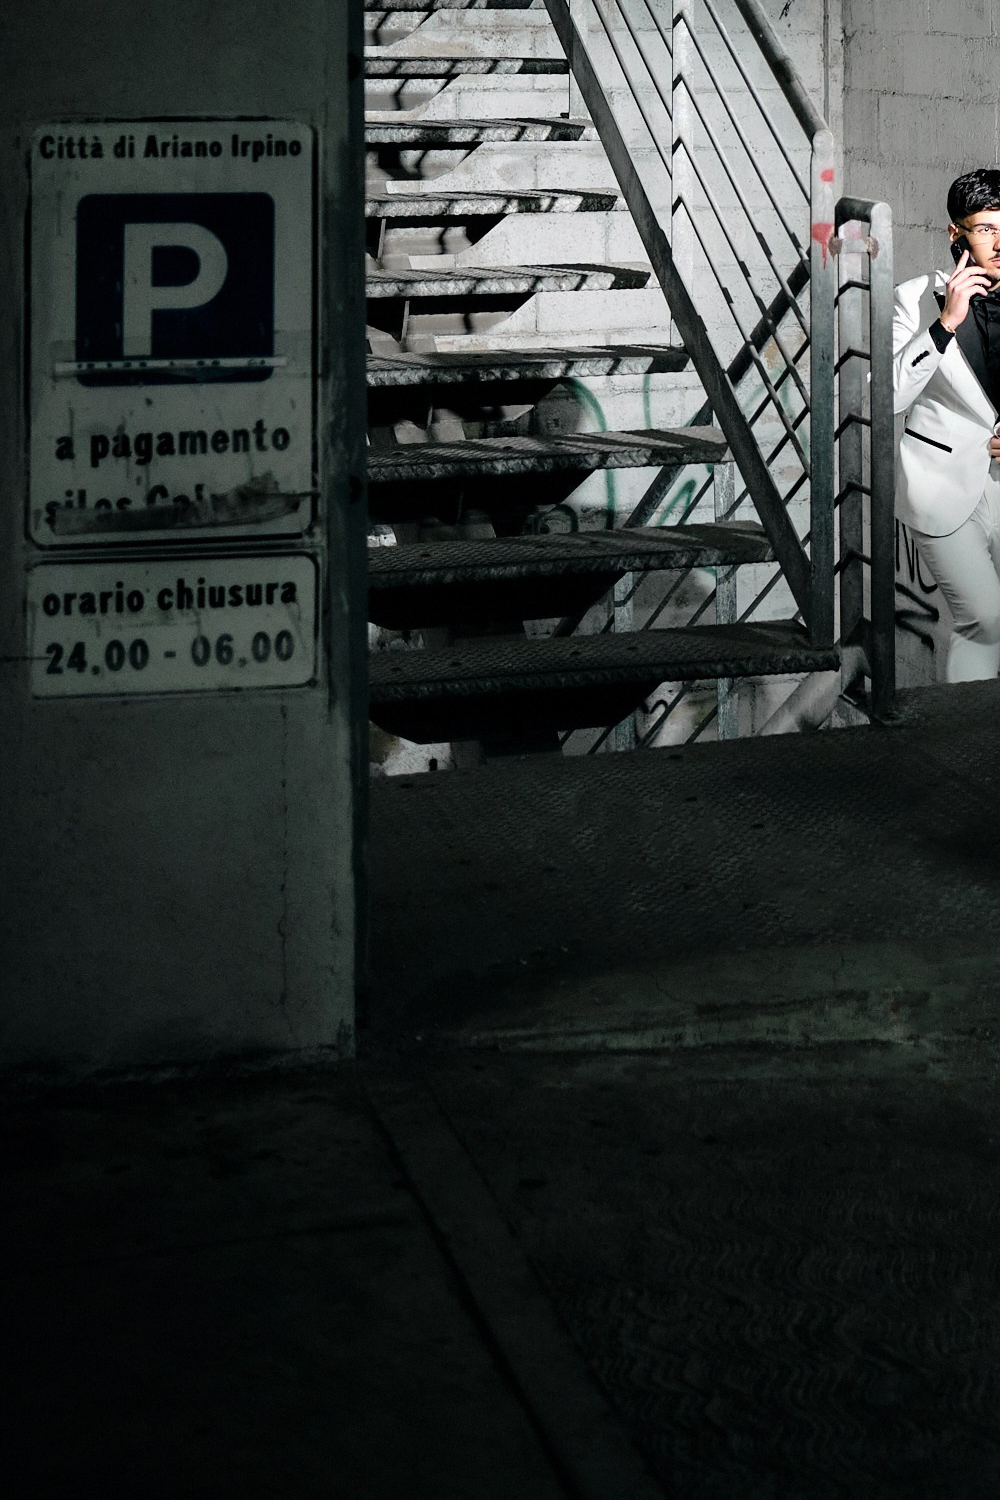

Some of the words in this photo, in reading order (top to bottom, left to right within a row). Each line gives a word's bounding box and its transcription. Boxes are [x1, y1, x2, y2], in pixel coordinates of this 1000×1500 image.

[40, 135, 104, 159] Città
[114, 135, 135, 158] di
[144, 135, 222, 158] Ariano
[231, 134, 301, 162] Irpino
[123, 222, 228, 357] P
[56, 436, 74, 460] a
[91, 419, 290, 468] pagamento
[43, 582, 145, 616] orario
[157, 577, 296, 611] chiusura
[46, 639, 149, 675] 24.00
[191, 630, 294, 668] 06.00
